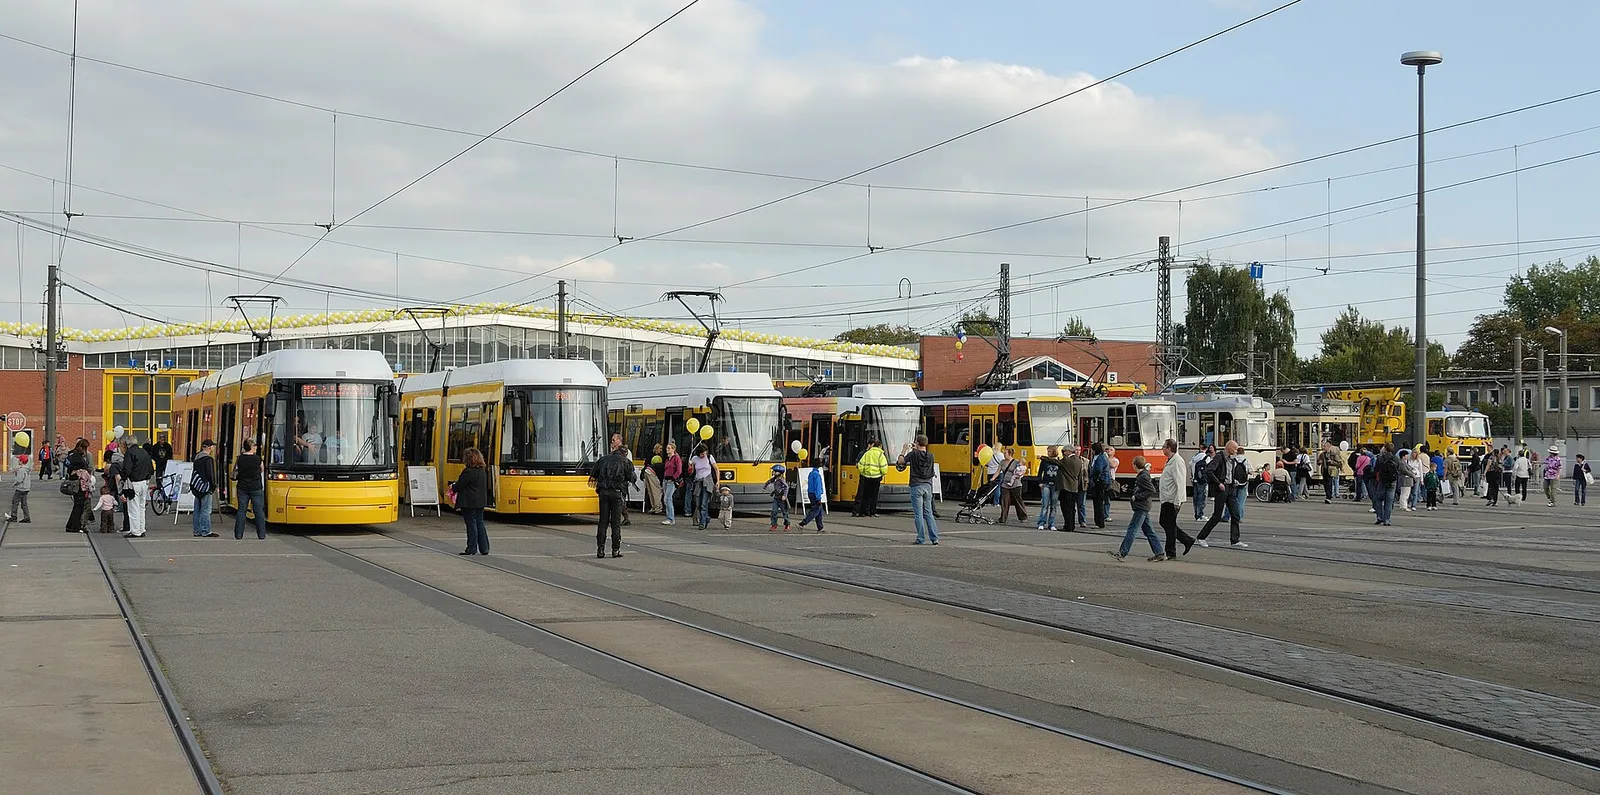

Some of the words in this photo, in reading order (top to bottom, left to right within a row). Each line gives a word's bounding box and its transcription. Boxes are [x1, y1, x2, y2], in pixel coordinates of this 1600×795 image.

[146, 363, 158, 372] 14
[1109, 374, 1116, 382] 5
[8, 418, 24, 426] STOP
